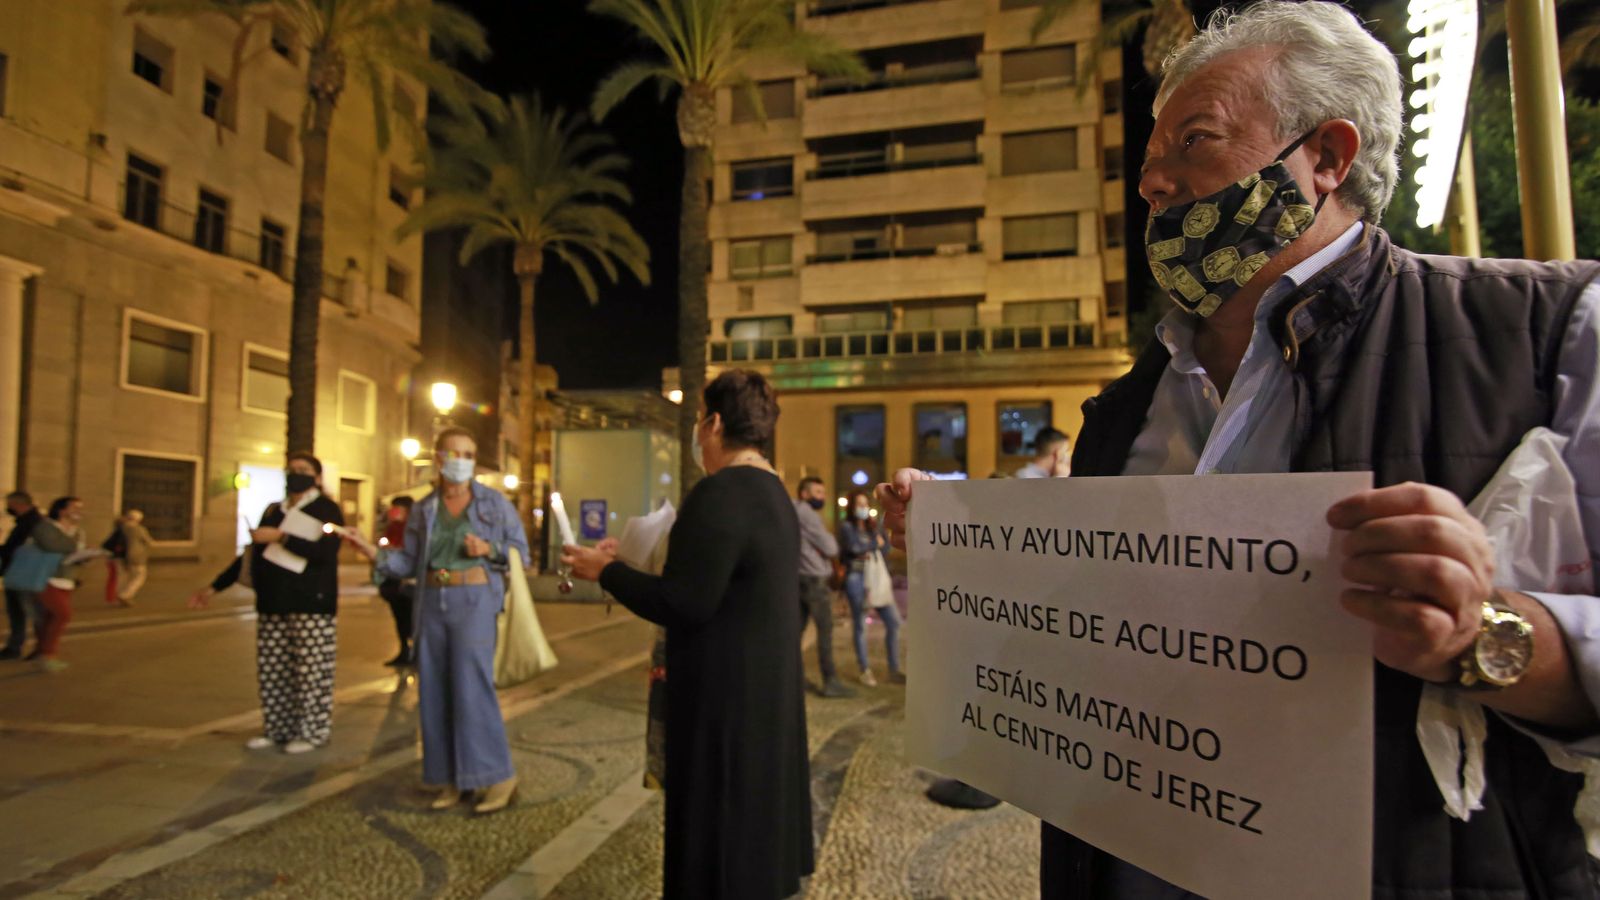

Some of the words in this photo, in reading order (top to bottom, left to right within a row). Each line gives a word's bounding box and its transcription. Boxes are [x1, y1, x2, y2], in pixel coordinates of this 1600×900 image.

[929, 522, 995, 551] JUNTA
[999, 525, 1015, 552] Y
[1020, 526, 1312, 583] AYUNTAMIENTO,
[936, 585, 1060, 635] PÓNGANSE
[1068, 610, 1105, 645] DE
[1114, 619, 1308, 681] ACUERDO
[975, 663, 1048, 709] ESTÁIS
[1056, 687, 1221, 762] MATANDO
[961, 701, 988, 732] AL
[992, 712, 1094, 771] CENTRO
[1103, 750, 1142, 792] DE
[1151, 769, 1264, 836] JEREZ
